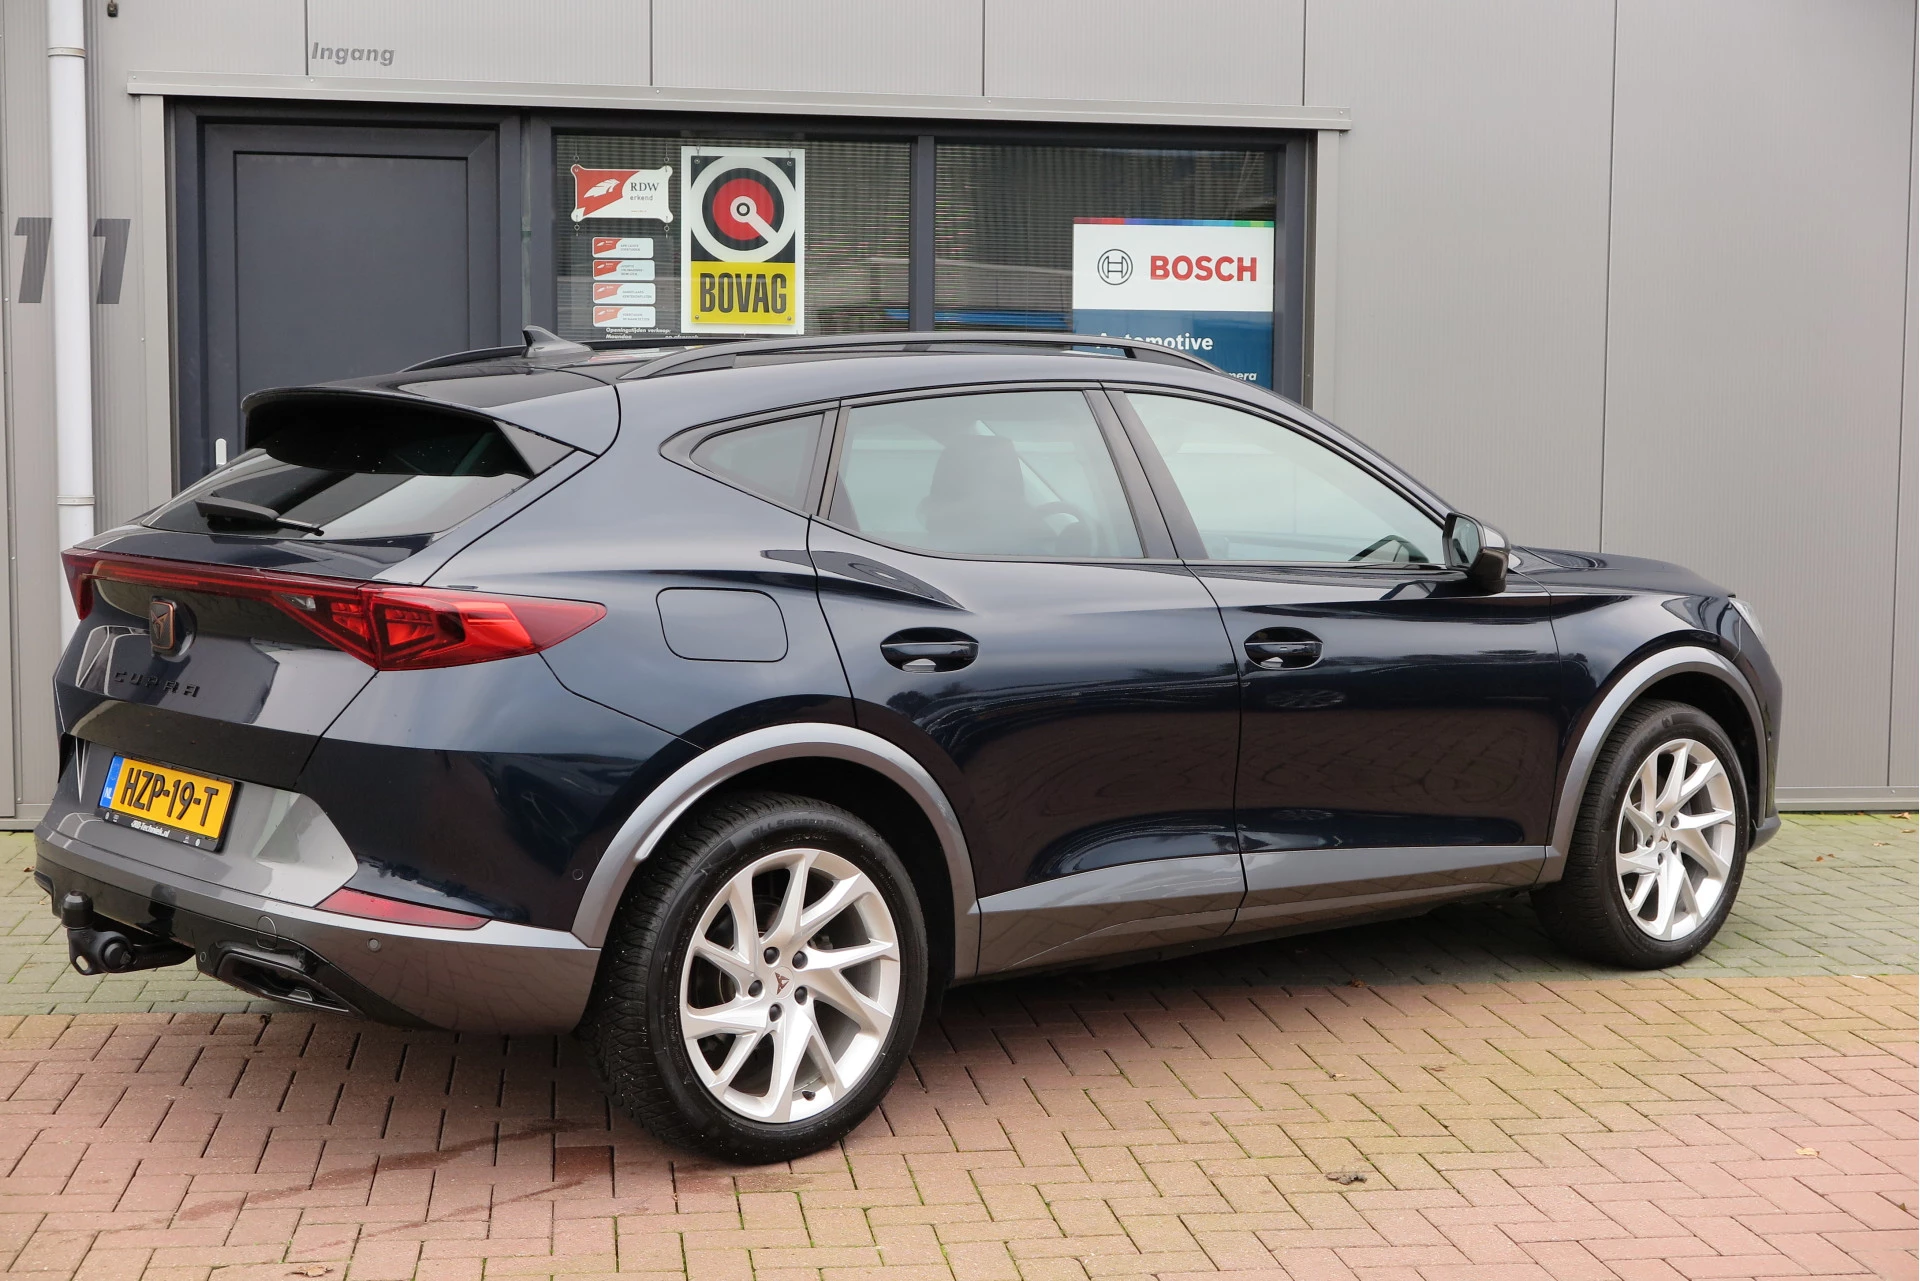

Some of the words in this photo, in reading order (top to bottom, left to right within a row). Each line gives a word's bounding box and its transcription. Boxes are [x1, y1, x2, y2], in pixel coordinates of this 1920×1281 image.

[311, 42, 395, 66] Ingang
[630, 182, 659, 192] RDW
[14, 217, 131, 304] 11
[1150, 255, 1257, 282] BOSCH
[699, 272, 787, 314] BOVAG
[114, 671, 201, 698] CUPRA
[103, 786, 113, 800] NL
[120, 767, 219, 827] HZP-19-T
